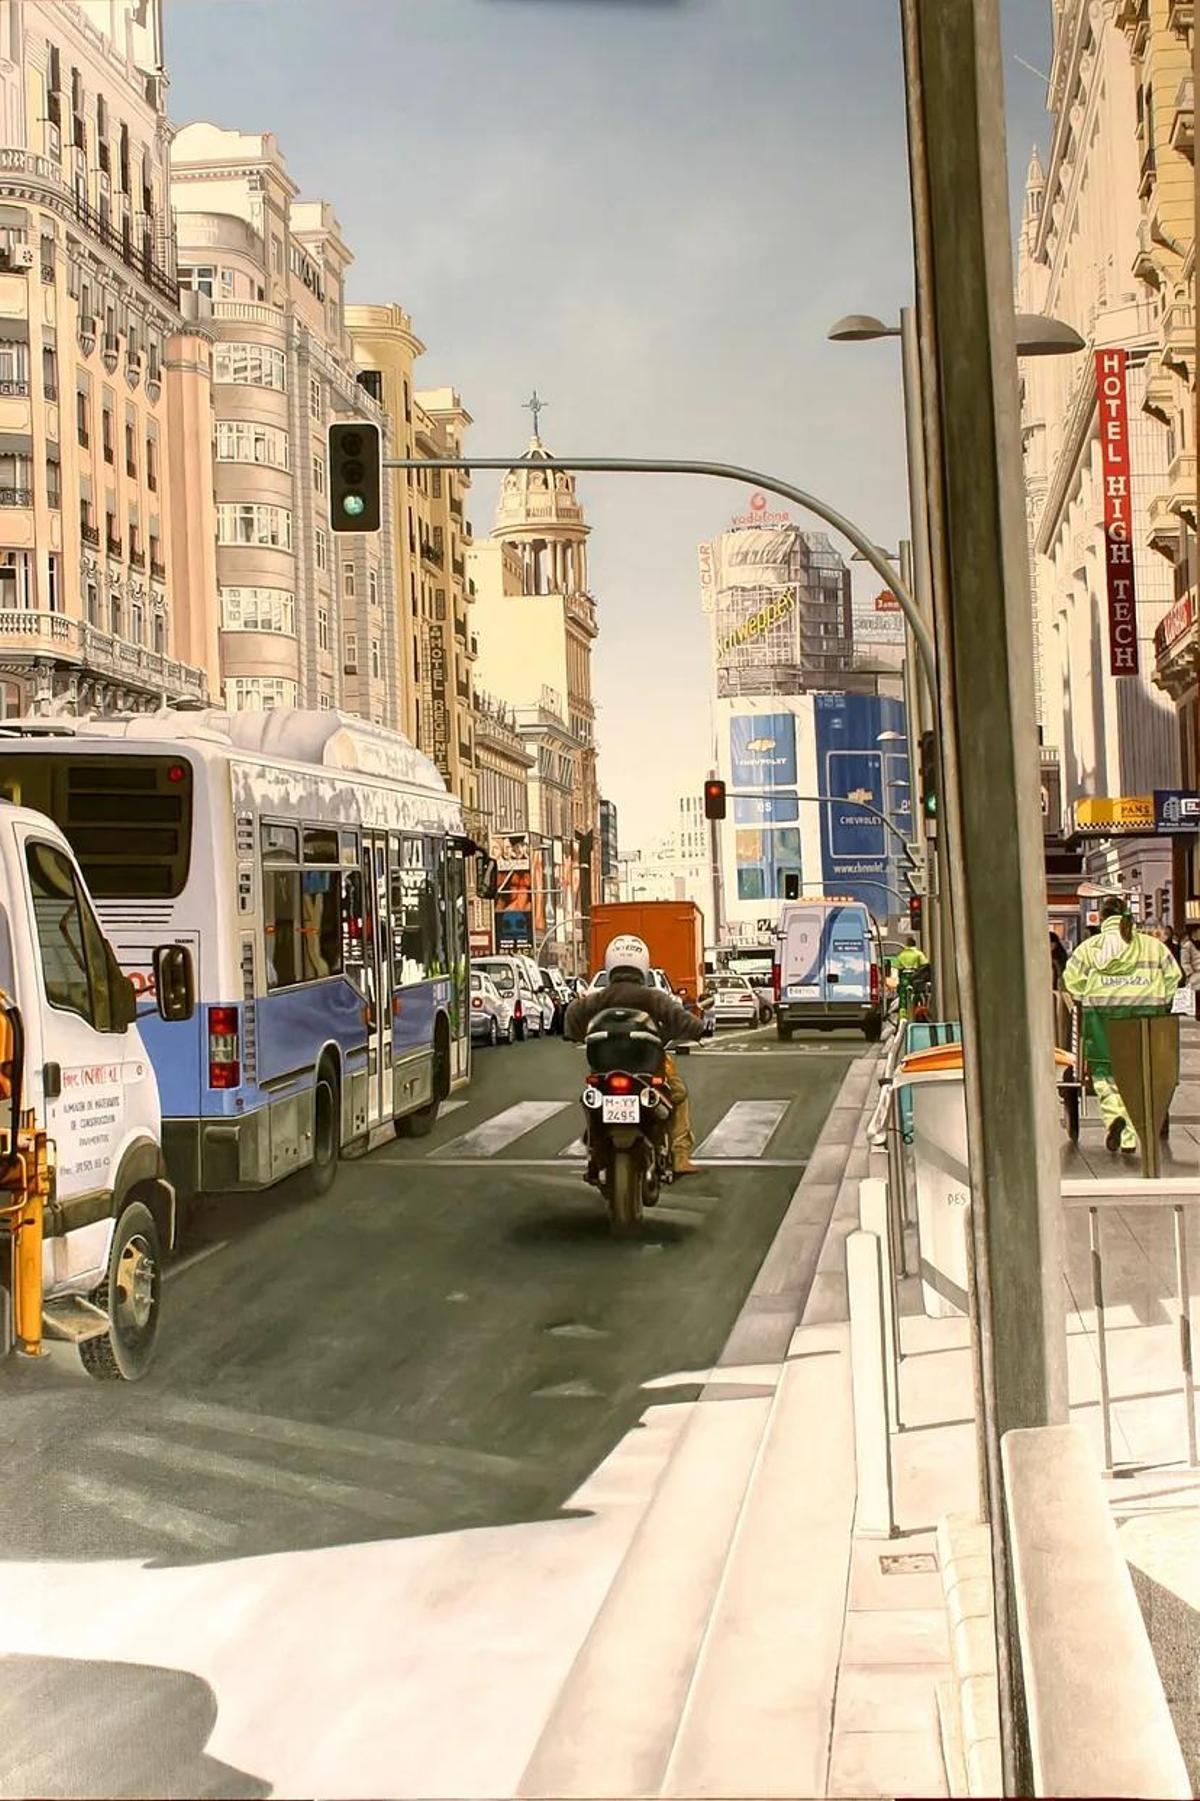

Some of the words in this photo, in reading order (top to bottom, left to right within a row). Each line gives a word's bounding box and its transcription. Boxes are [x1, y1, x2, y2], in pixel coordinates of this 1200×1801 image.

[1102, 354, 1122, 462] HOTEL
[1106, 475, 1132, 564] HIGH
[431, 637, 445, 692] HOTEL
[1113, 579, 1135, 668] TECH
[839, 816, 882, 825] CHEVROLET
